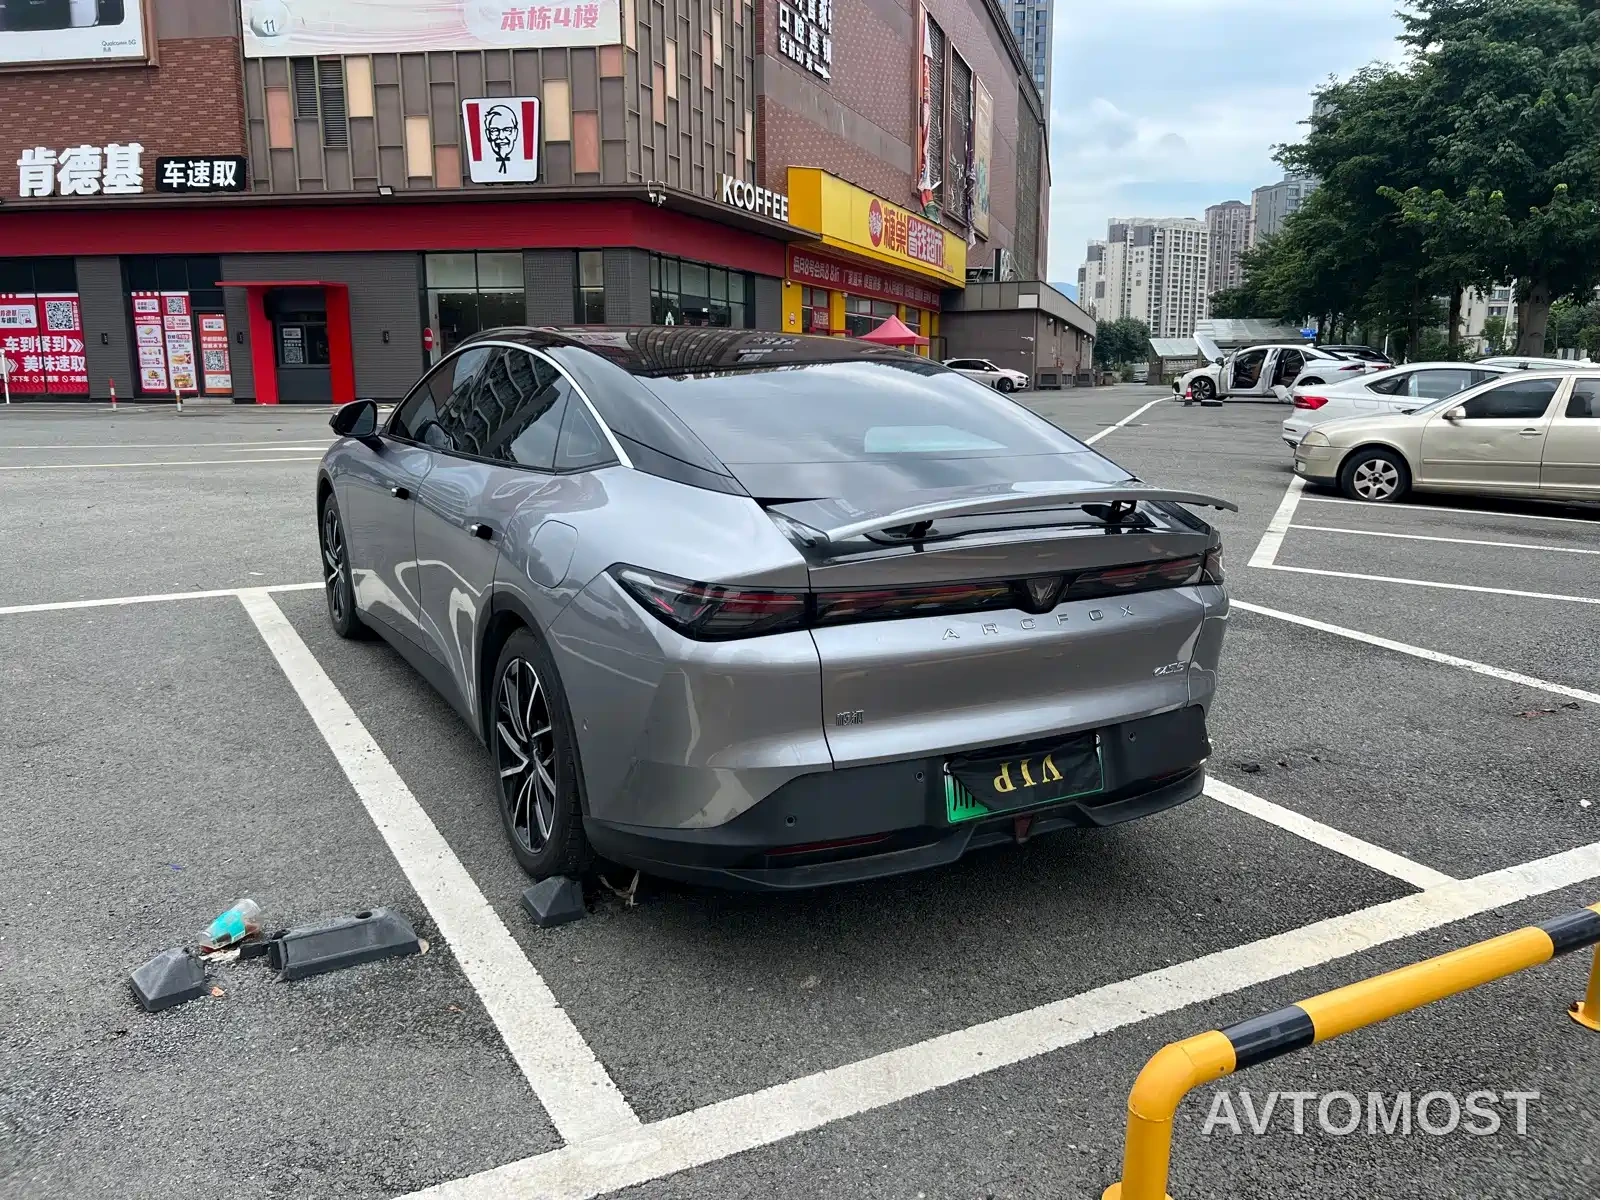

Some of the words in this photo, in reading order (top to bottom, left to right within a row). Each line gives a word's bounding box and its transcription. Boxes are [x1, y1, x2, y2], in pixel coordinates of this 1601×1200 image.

[264, 19, 275, 32] 11
[501, 4, 599, 31] 本栋4楼
[17, 143, 144, 196] 肯德基
[162, 160, 237, 188] 车速取
[722, 173, 788, 222] KCOFFEE
[3, 336, 67, 353] 车到餐到
[22, 355, 86, 372] 美味速取
[942, 605, 1135, 640] ARCFOX
[993, 754, 1063, 793] VIP
